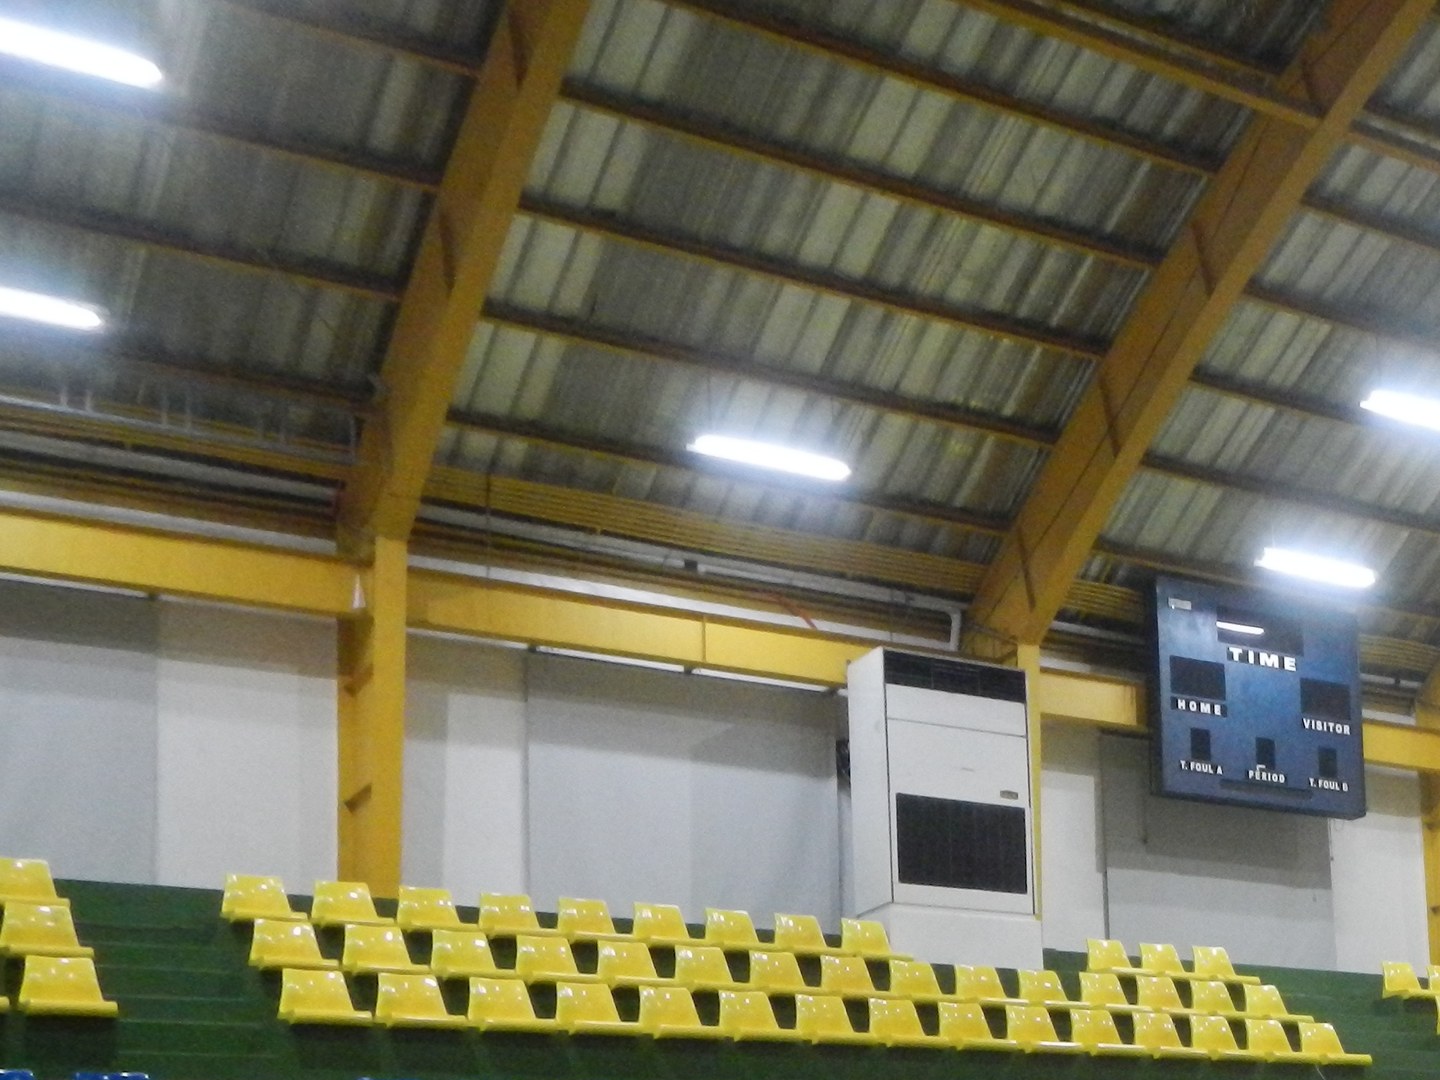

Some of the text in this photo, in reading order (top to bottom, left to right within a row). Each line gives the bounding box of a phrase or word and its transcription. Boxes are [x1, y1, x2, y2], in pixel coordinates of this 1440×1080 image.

[1229, 647, 1296, 671] TIME
[1177, 699, 1222, 716] HOME
[1303, 718, 1350, 735] VISITOR
[1179, 759, 1224, 775] T. FOUL A
[1248, 769, 1286, 784] PERIOD
[1309, 777, 1317, 787] T.
[1318, 780, 1340, 790] FOUL
